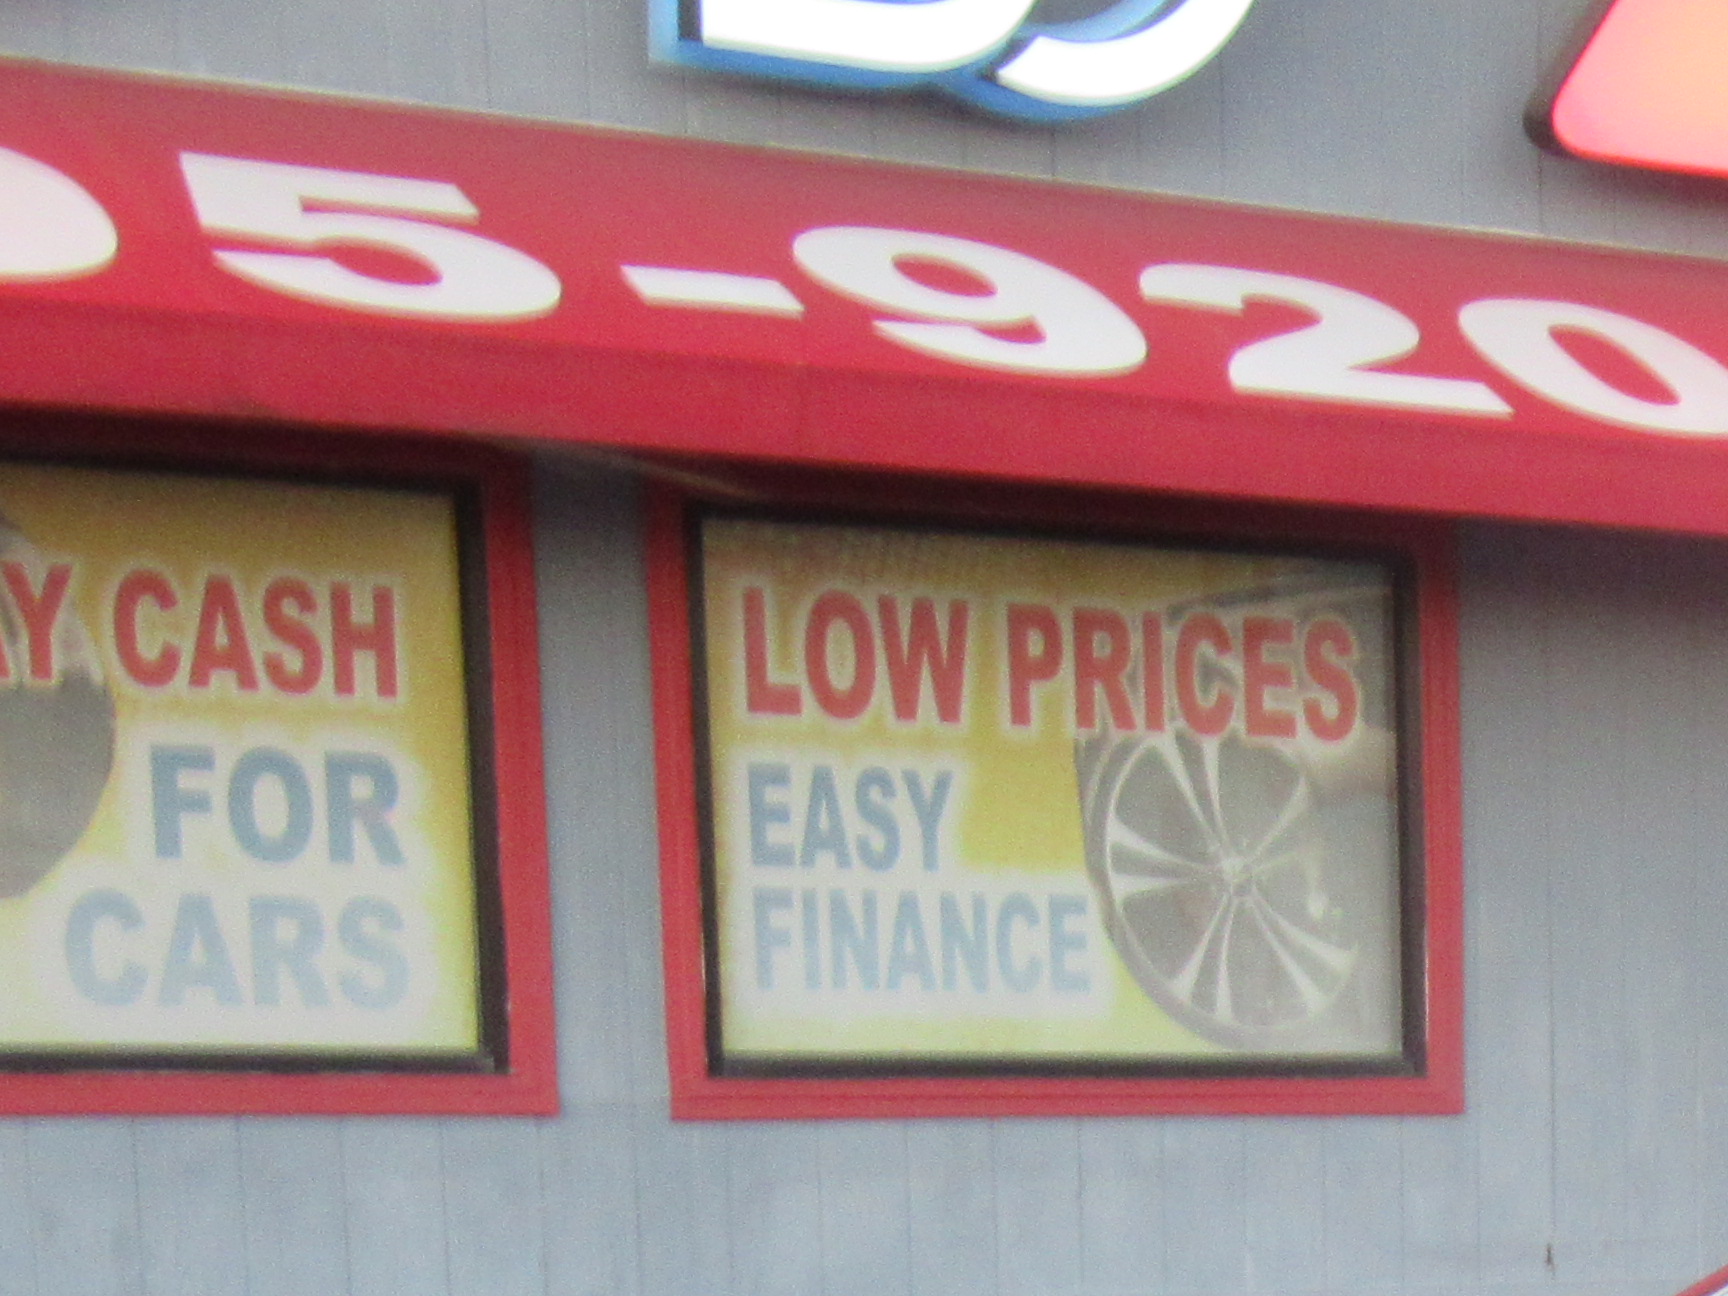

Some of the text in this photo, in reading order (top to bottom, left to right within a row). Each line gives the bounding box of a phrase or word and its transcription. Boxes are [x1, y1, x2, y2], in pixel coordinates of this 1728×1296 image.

[0, 561, 399, 698] Y CASH
[743, 588, 1359, 743] LOW PRICES
[149, 744, 405, 866] FOR
[745, 762, 954, 874] EASY
[64, 892, 409, 1011] CARS
[751, 887, 1092, 996] FINANCE
